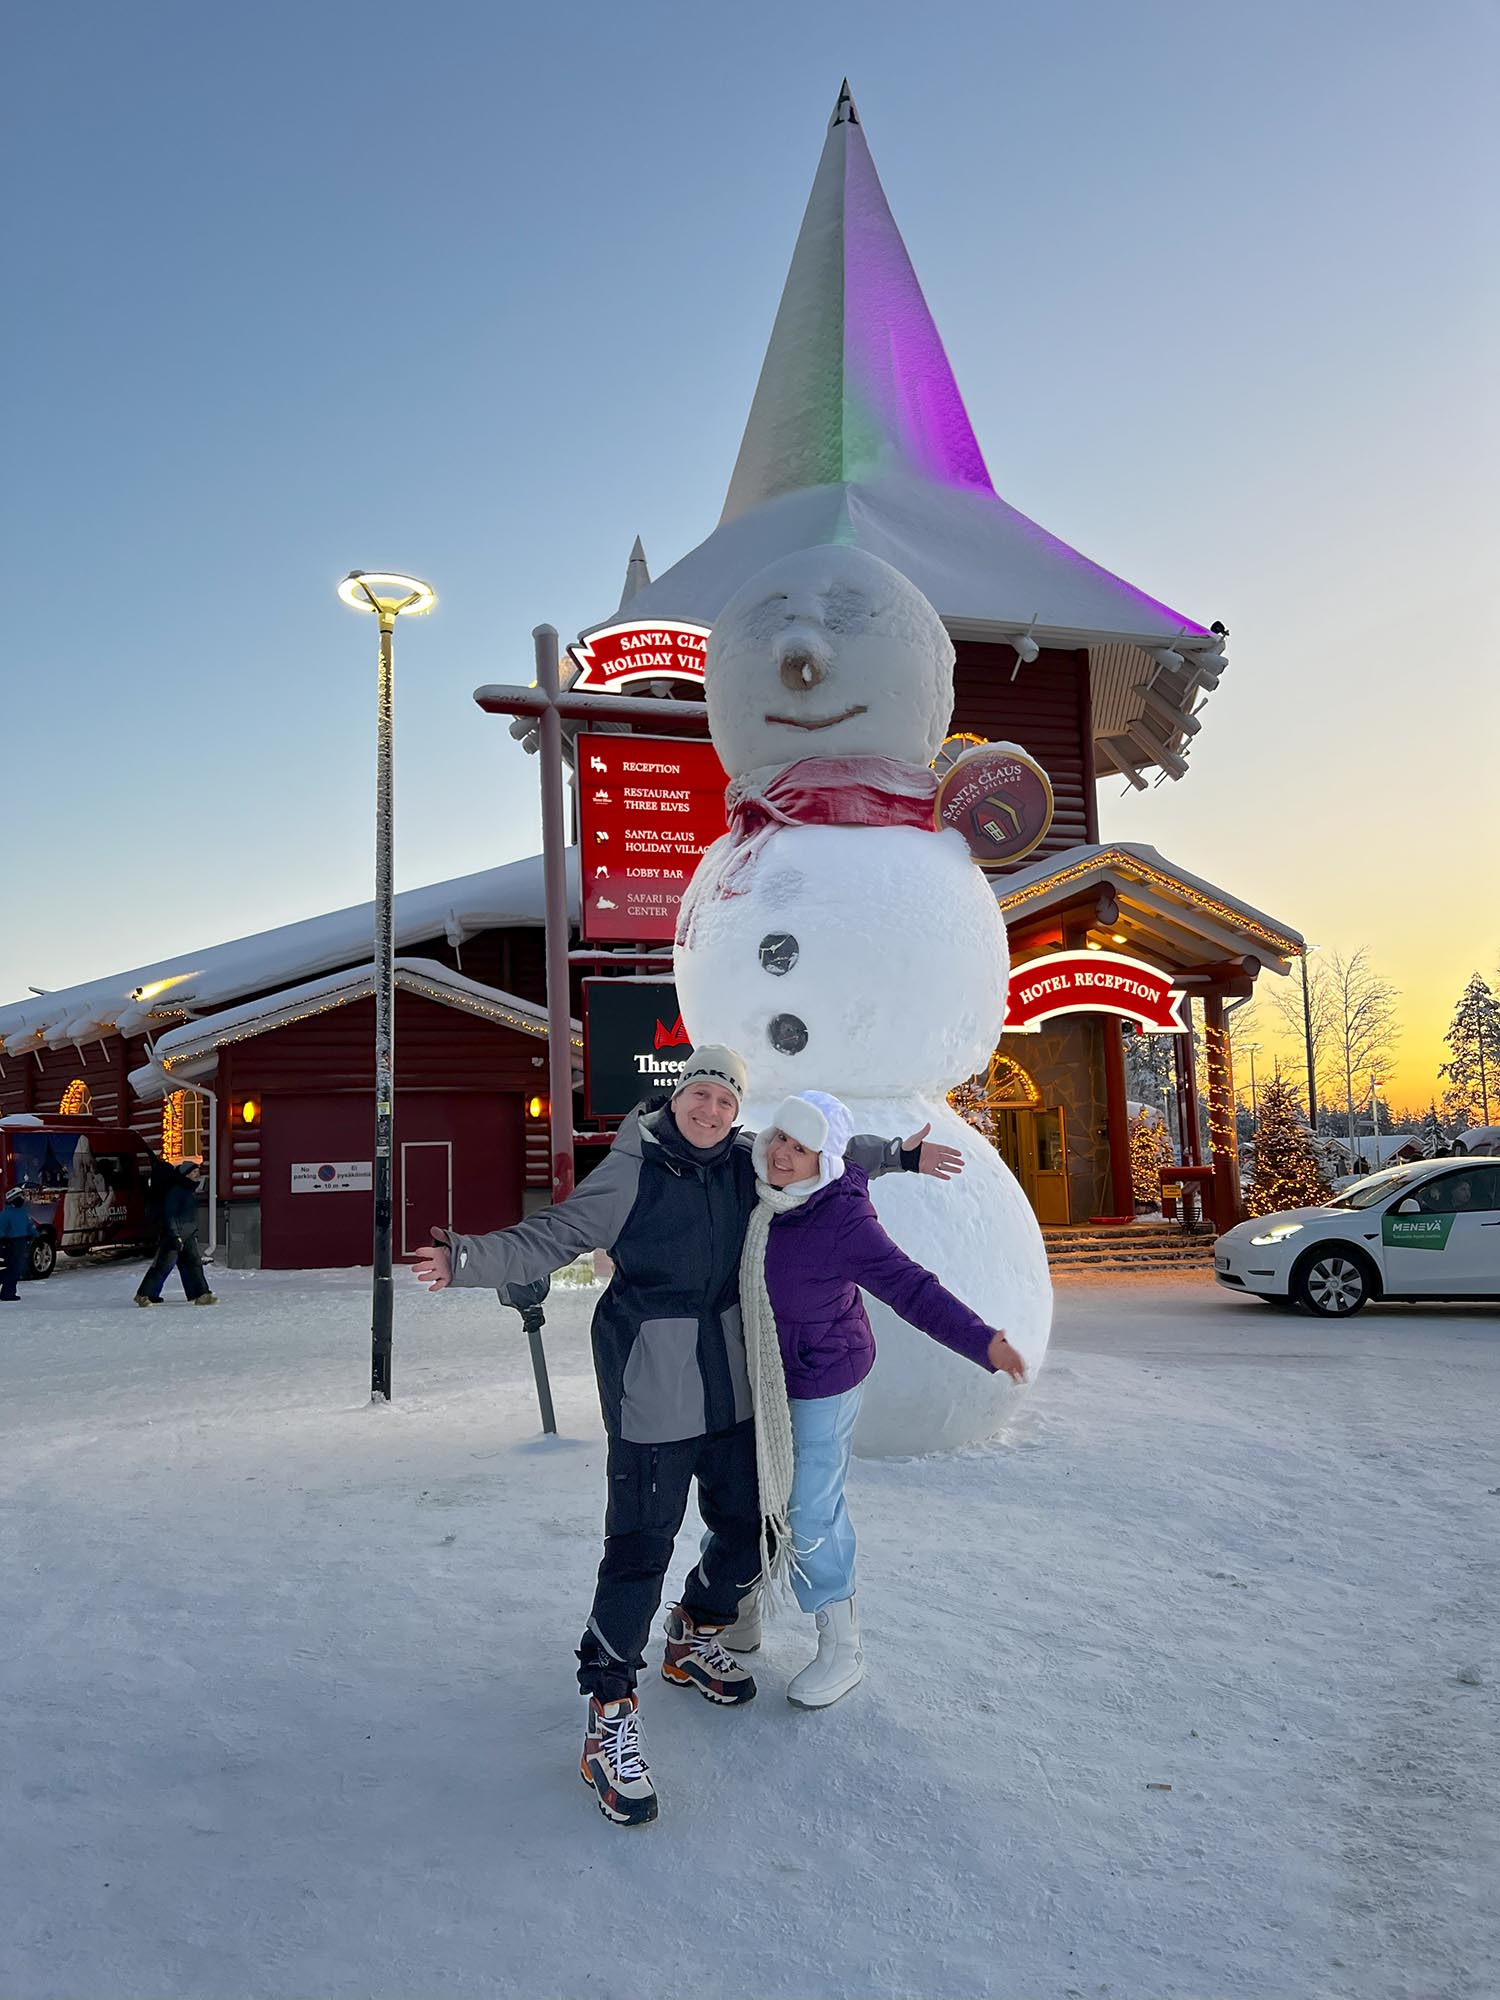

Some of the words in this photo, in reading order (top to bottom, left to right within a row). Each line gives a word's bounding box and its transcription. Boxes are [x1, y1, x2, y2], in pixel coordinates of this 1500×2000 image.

[620, 633, 673, 651] SANTA
[601, 653, 673, 675] HOLIDAY
[623, 762, 680, 774] RECEPTION
[624, 787, 690, 800] RESTAURANT
[943, 783, 979, 819] SANTA
[978, 764, 1022, 785] CLAUS
[951, 790, 981, 822] HOLIDAY
[983, 775, 1021, 791] VILLAGE
[624, 800, 658, 811] THREE
[660, 801, 690, 812] ELVES
[625, 829, 659, 840] SANTA
[661, 831, 695, 841] CLAUS
[625, 842, 672, 853] HOLIDAY
[626, 867, 661, 878] LOBBY
[663, 869, 684, 879] BAR
[627, 893, 663, 904] SAFARI
[627, 906, 668, 917] CENTER
[1019, 974, 1071, 1004] HOTEL
[1074, 972, 1161, 1004] RECEPTION
[108, 1205, 128, 1215] CLAUS
[1392, 1220, 1442, 1232] MENEVÄ
